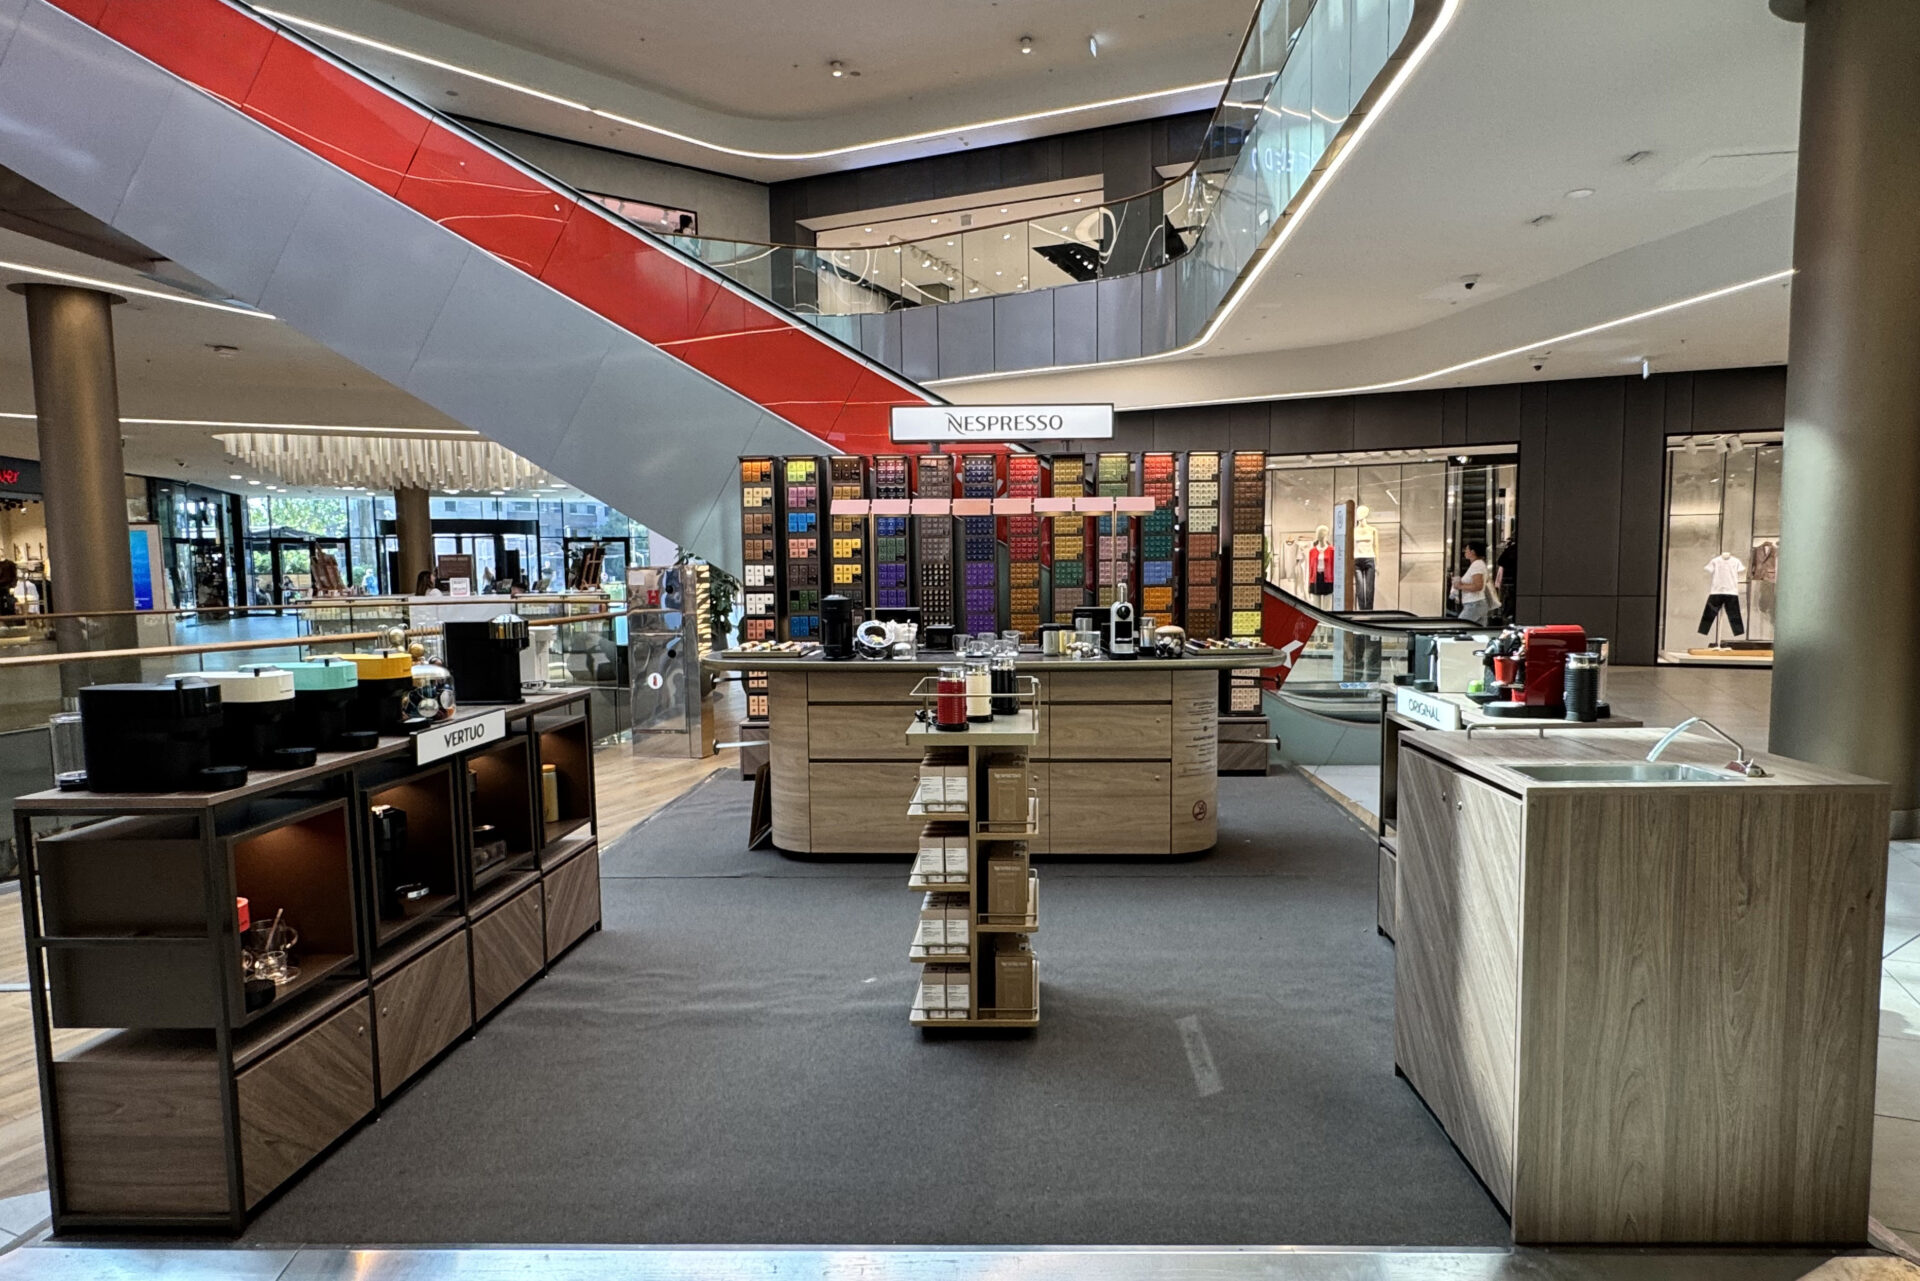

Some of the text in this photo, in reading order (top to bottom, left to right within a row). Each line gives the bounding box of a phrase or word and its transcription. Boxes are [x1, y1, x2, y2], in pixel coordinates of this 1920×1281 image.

[944, 412, 1063, 435] NESPRESSO
[1408, 698, 1441, 722] ORIGINAL
[444, 723, 485, 747] VERTUO
